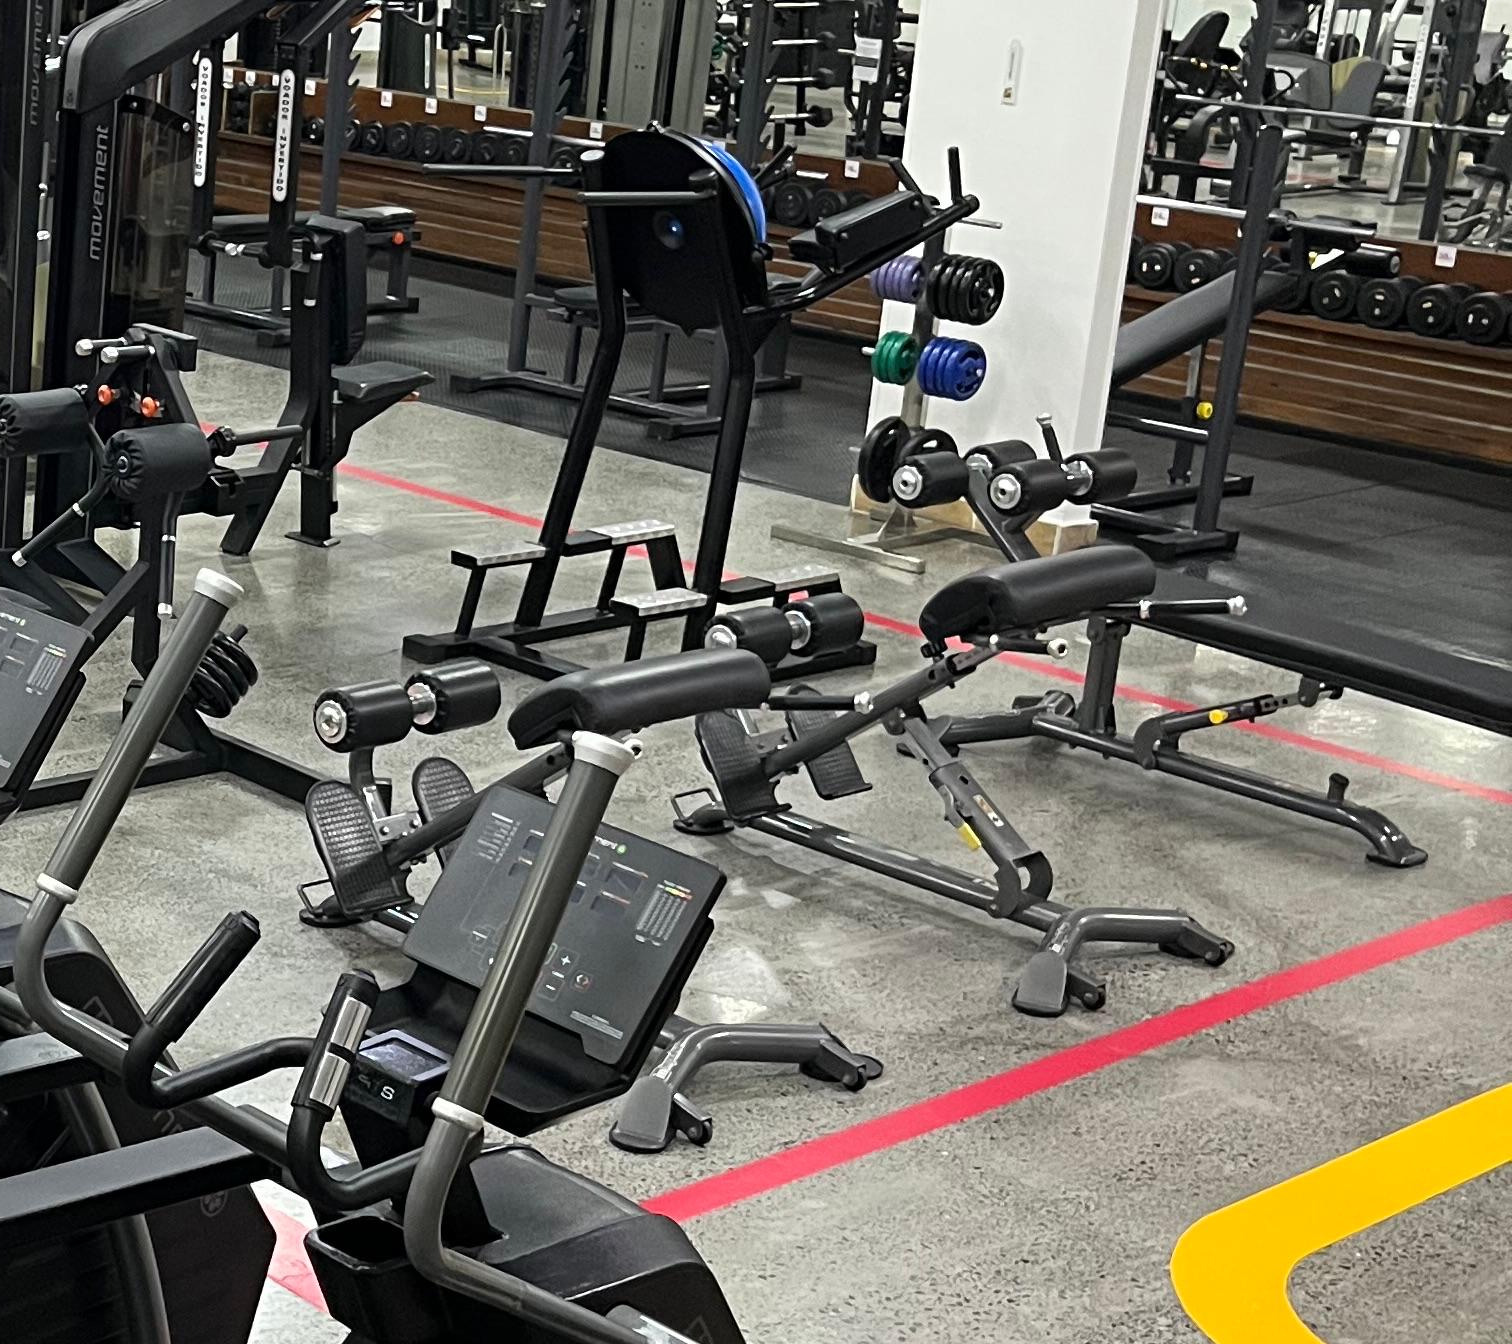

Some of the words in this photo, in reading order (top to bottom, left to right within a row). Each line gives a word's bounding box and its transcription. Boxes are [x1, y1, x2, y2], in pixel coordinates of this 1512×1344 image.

[200, 65, 209, 107] VOADOR
[282, 77, 291, 121] VOADOR
[276, 128, 287, 192] INVERTIDO
[89, 125, 109, 261] movement
